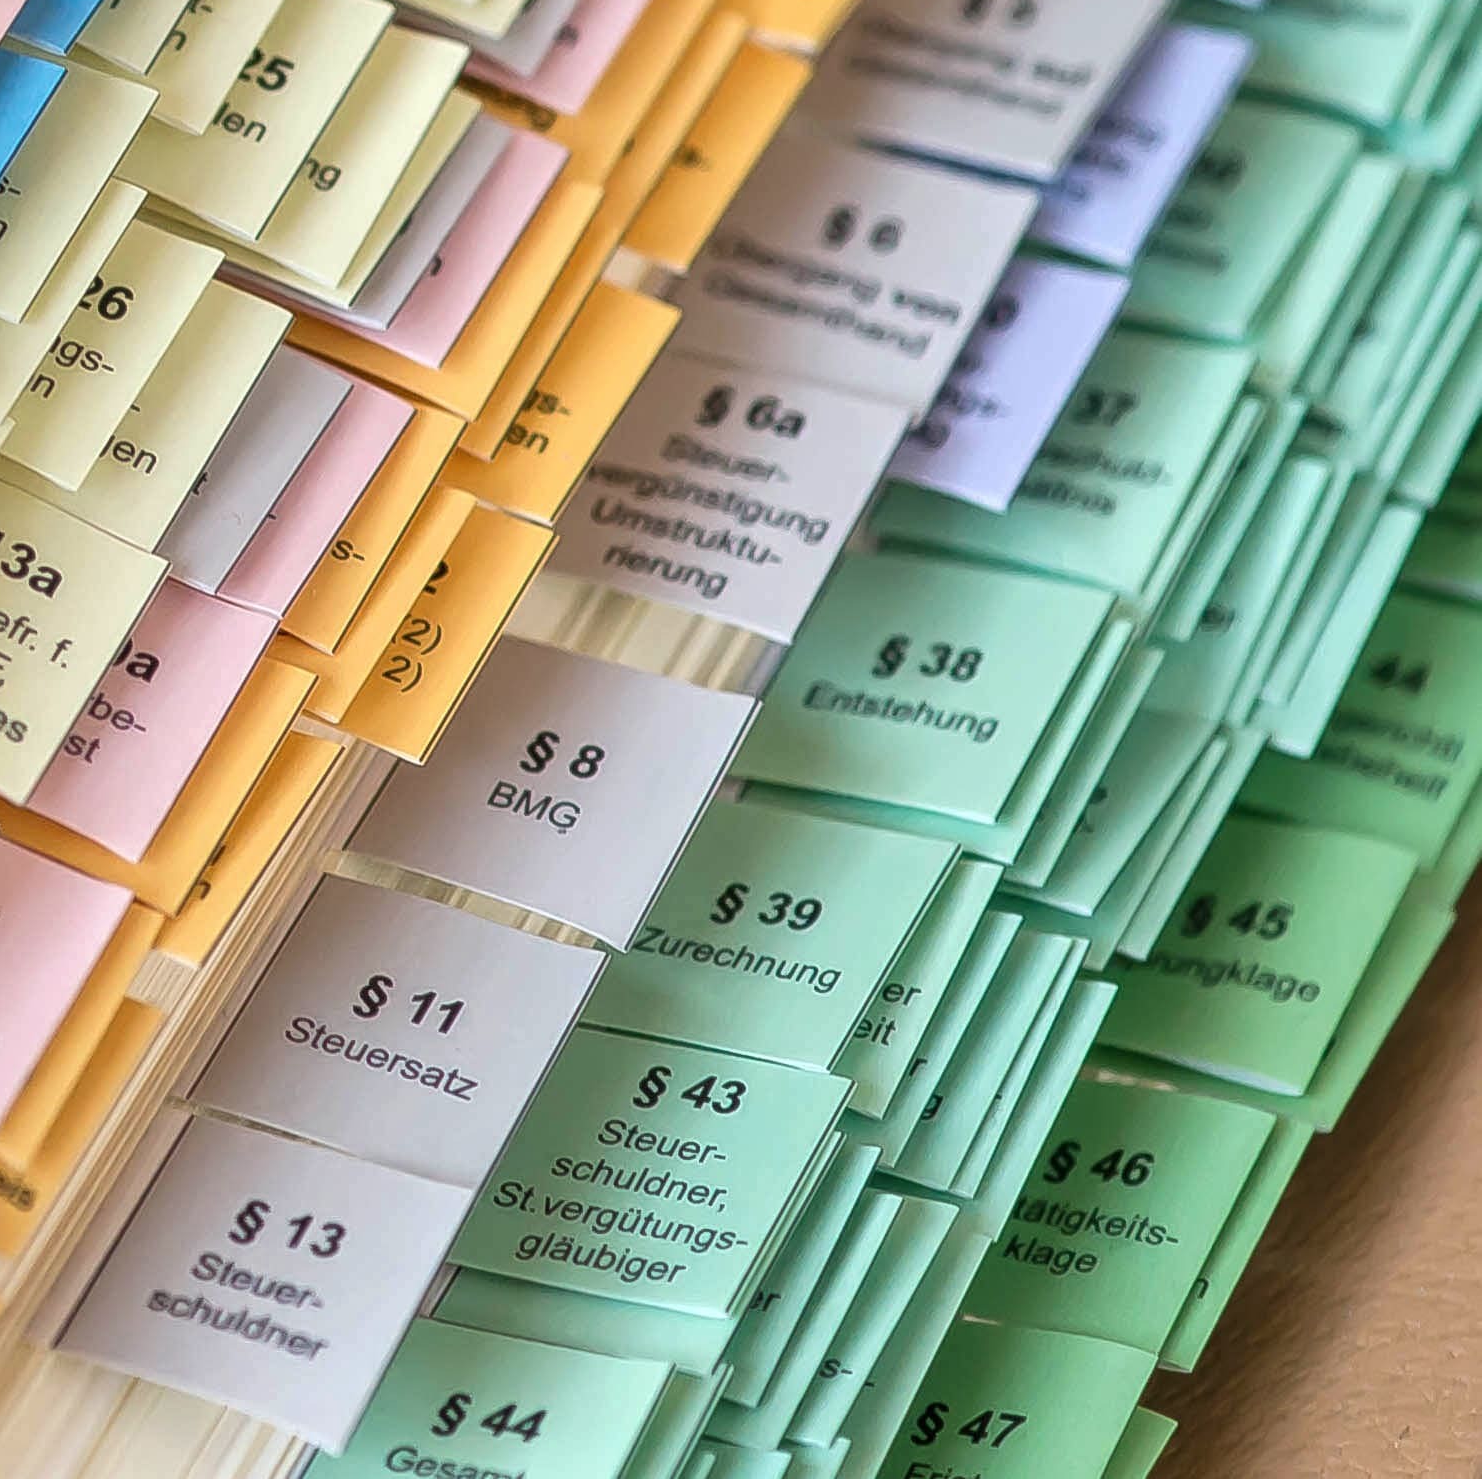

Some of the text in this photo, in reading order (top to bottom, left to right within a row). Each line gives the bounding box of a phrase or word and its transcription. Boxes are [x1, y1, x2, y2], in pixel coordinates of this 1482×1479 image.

[746, 396, 808, 440] 6a
[591, 495, 783, 567] Umstruktu-
[603, 541, 728, 600] rierung
[49, 638, 76, 669] f.
[871, 632, 983, 682] § 38
[804, 682, 999, 743] Entstehung
[518, 729, 605, 779] § 8
[486, 779, 582, 835] BMG
[708, 882, 823, 931] § 39
[1228, 901, 1295, 941] 45
[635, 927, 842, 993] Zurechnung
[352, 974, 466, 1034] § 11
[284, 1016, 480, 1100] Steuersatz
[632, 1064, 747, 1114] § 43
[597, 1120, 727, 1164] Steuer-
[1043, 1141, 1155, 1187] § 46
[550, 1154, 728, 1214] schuldner,
[228, 1199, 347, 1260] § 13
[493, 1180, 749, 1255] St.vergütungs-
[191, 1252, 324, 1309] Steuer-
[514, 1233, 685, 1286] gläubiger
[1002, 1237, 1098, 1277] klage
[147, 1287, 328, 1360] schuldner
[431, 1393, 548, 1443] § 44
[910, 1402, 1027, 1449] § 47
